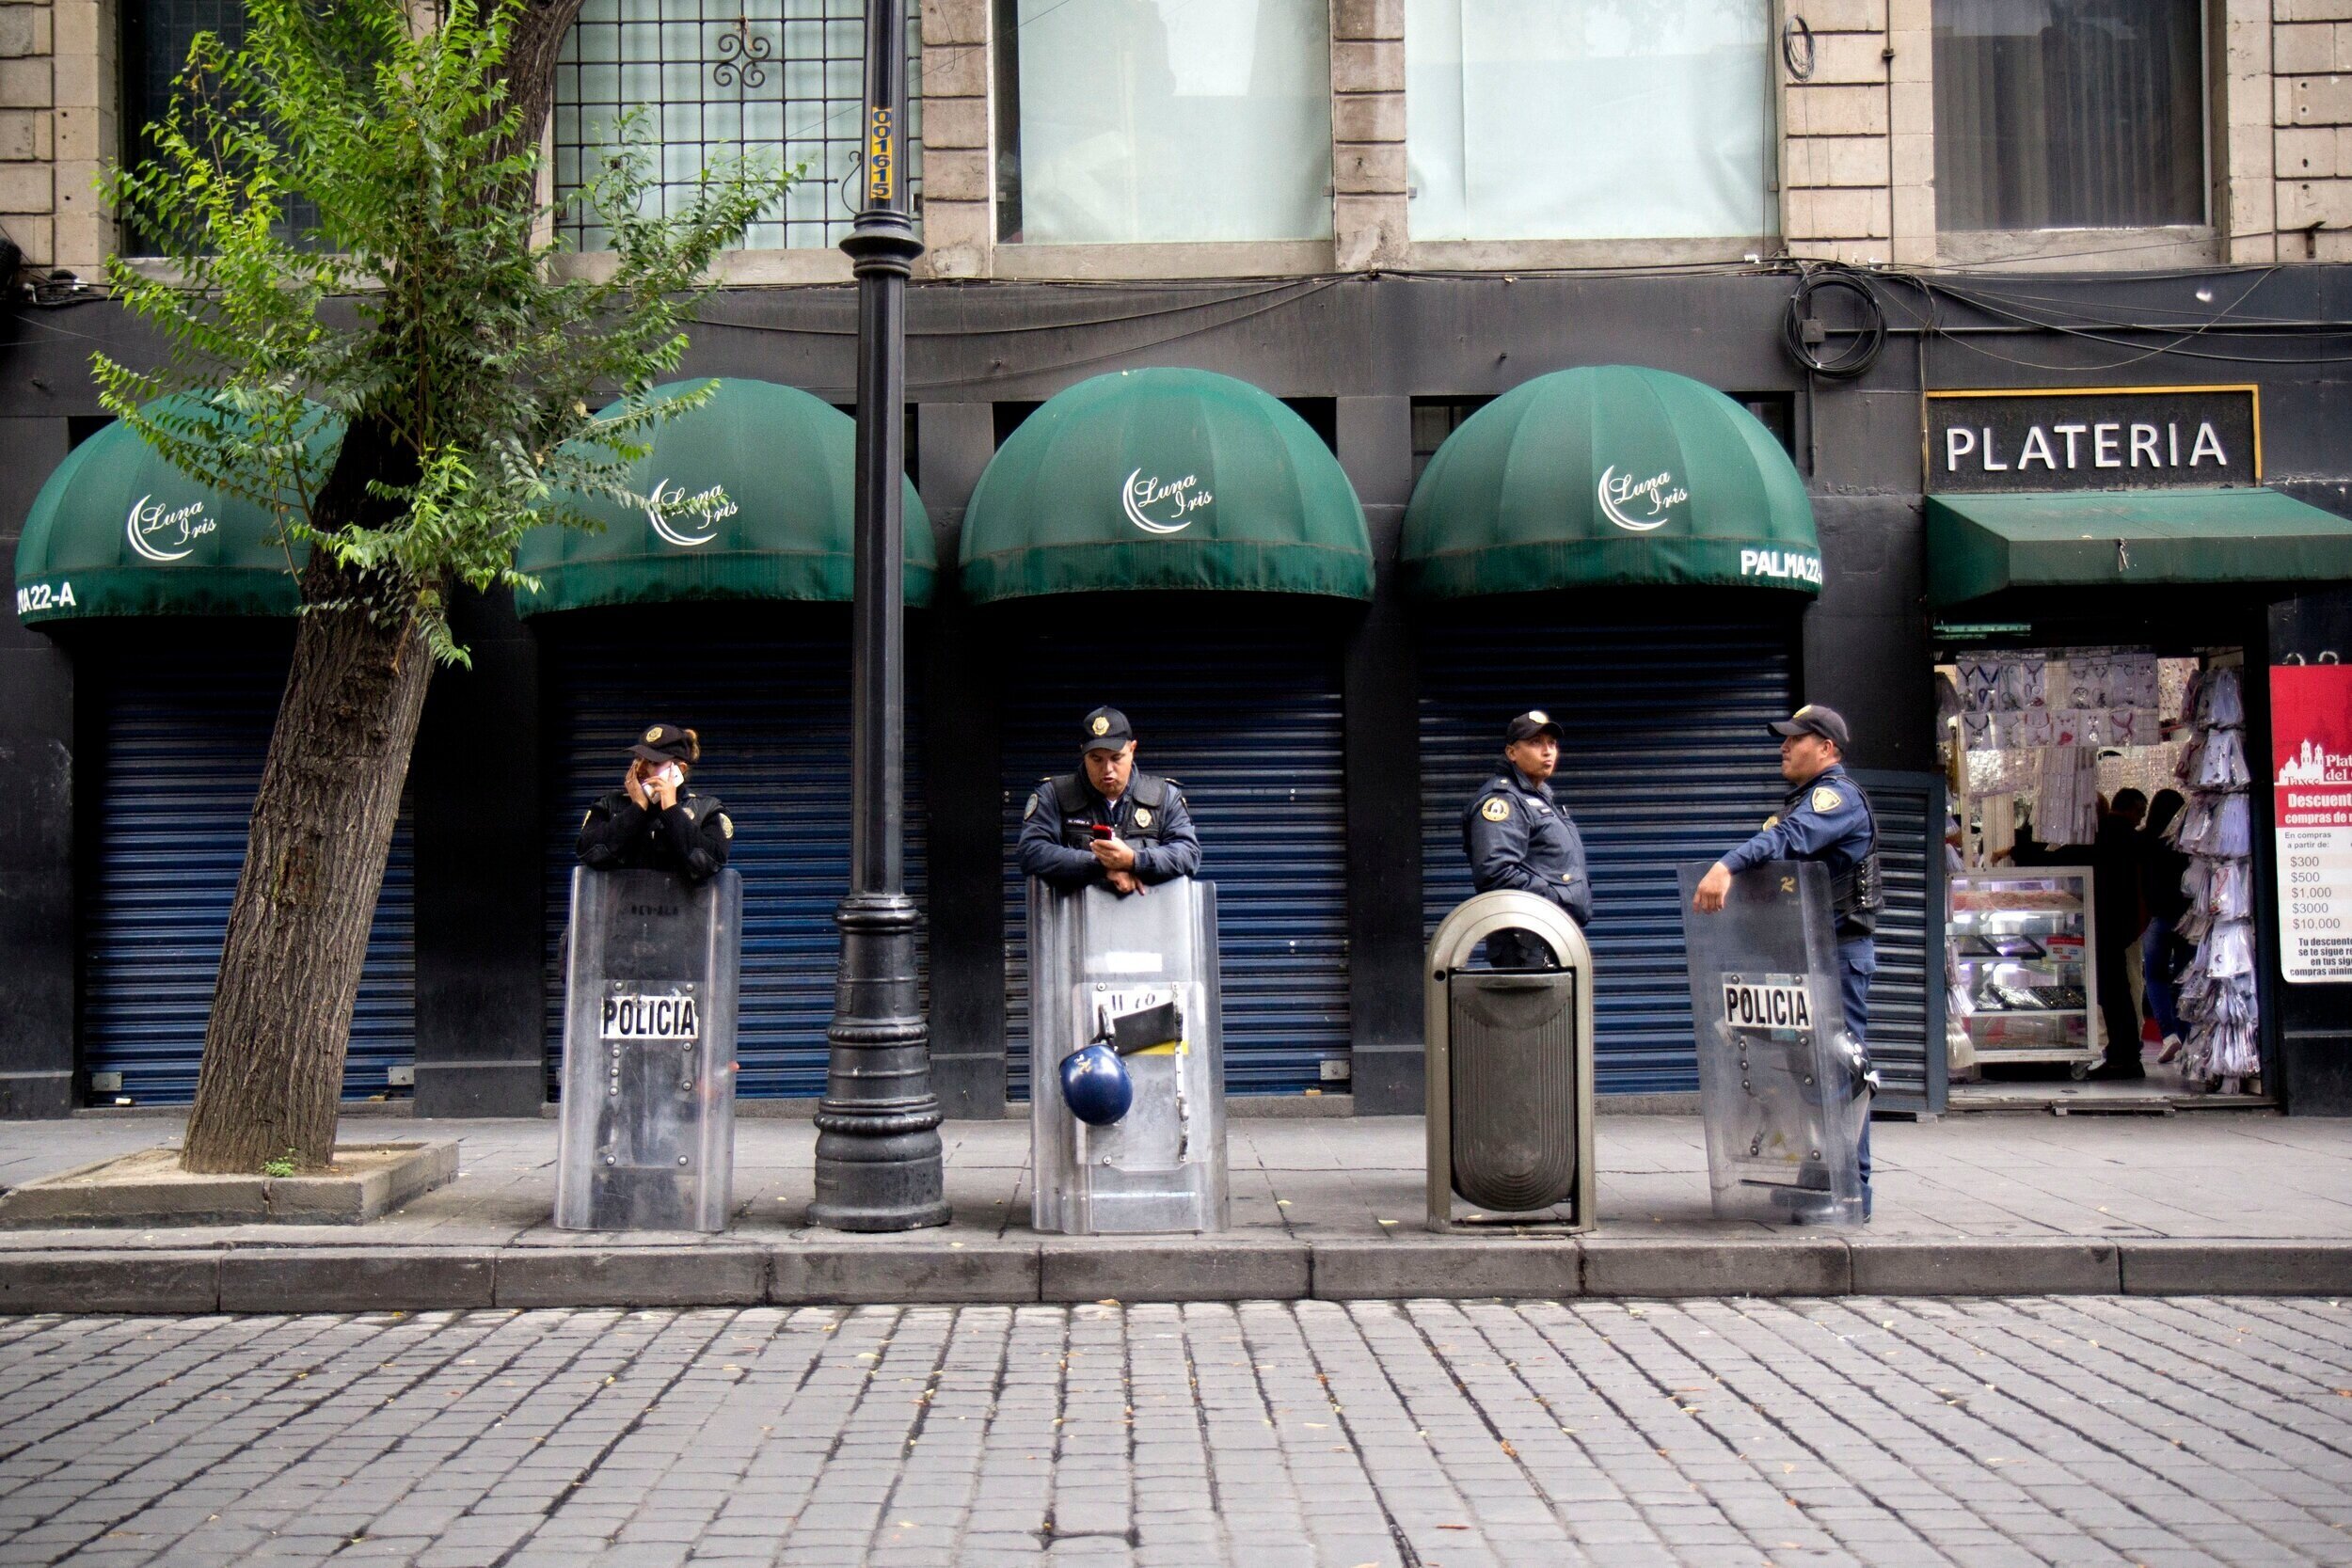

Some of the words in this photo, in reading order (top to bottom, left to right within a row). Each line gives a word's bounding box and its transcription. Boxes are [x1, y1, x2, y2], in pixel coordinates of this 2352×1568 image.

[873, 110, 892, 196] 001615
[1947, 422, 2227, 470] PLATERIA
[660, 484, 724, 519] Lna
[1134, 474, 1197, 508] Luna
[1608, 471, 1671, 505] Luna
[1646, 487, 1688, 515] Iris
[141, 500, 205, 533] Luna
[1170, 490, 1213, 518] Iris
[173, 517, 217, 546] Iris
[1740, 549, 1806, 580] PALMA
[30, 581, 77, 610] 22-A
[2325, 768, 2347, 782] del
[2284, 813, 2332, 825] compras
[2333, 812, 2347, 823] de
[2294, 841, 2315, 849] partir
[2296, 832, 2331, 841] compras
[2290, 856, 2319, 867] $300
[2290, 871, 2320, 883] $500
[2291, 887, 2332, 898] $1,000
[2292, 903, 2328, 914] $3000
[2293, 918, 2341, 930] $10,000
[2298, 937, 2309, 946] Tu
[2310, 947, 2319, 956] te
[2320, 947, 2344, 957] sigue
[2290, 968, 2327, 976] compras
[603, 999, 695, 1036] POLICIA
[1725, 987, 1809, 1026] POLICIA
